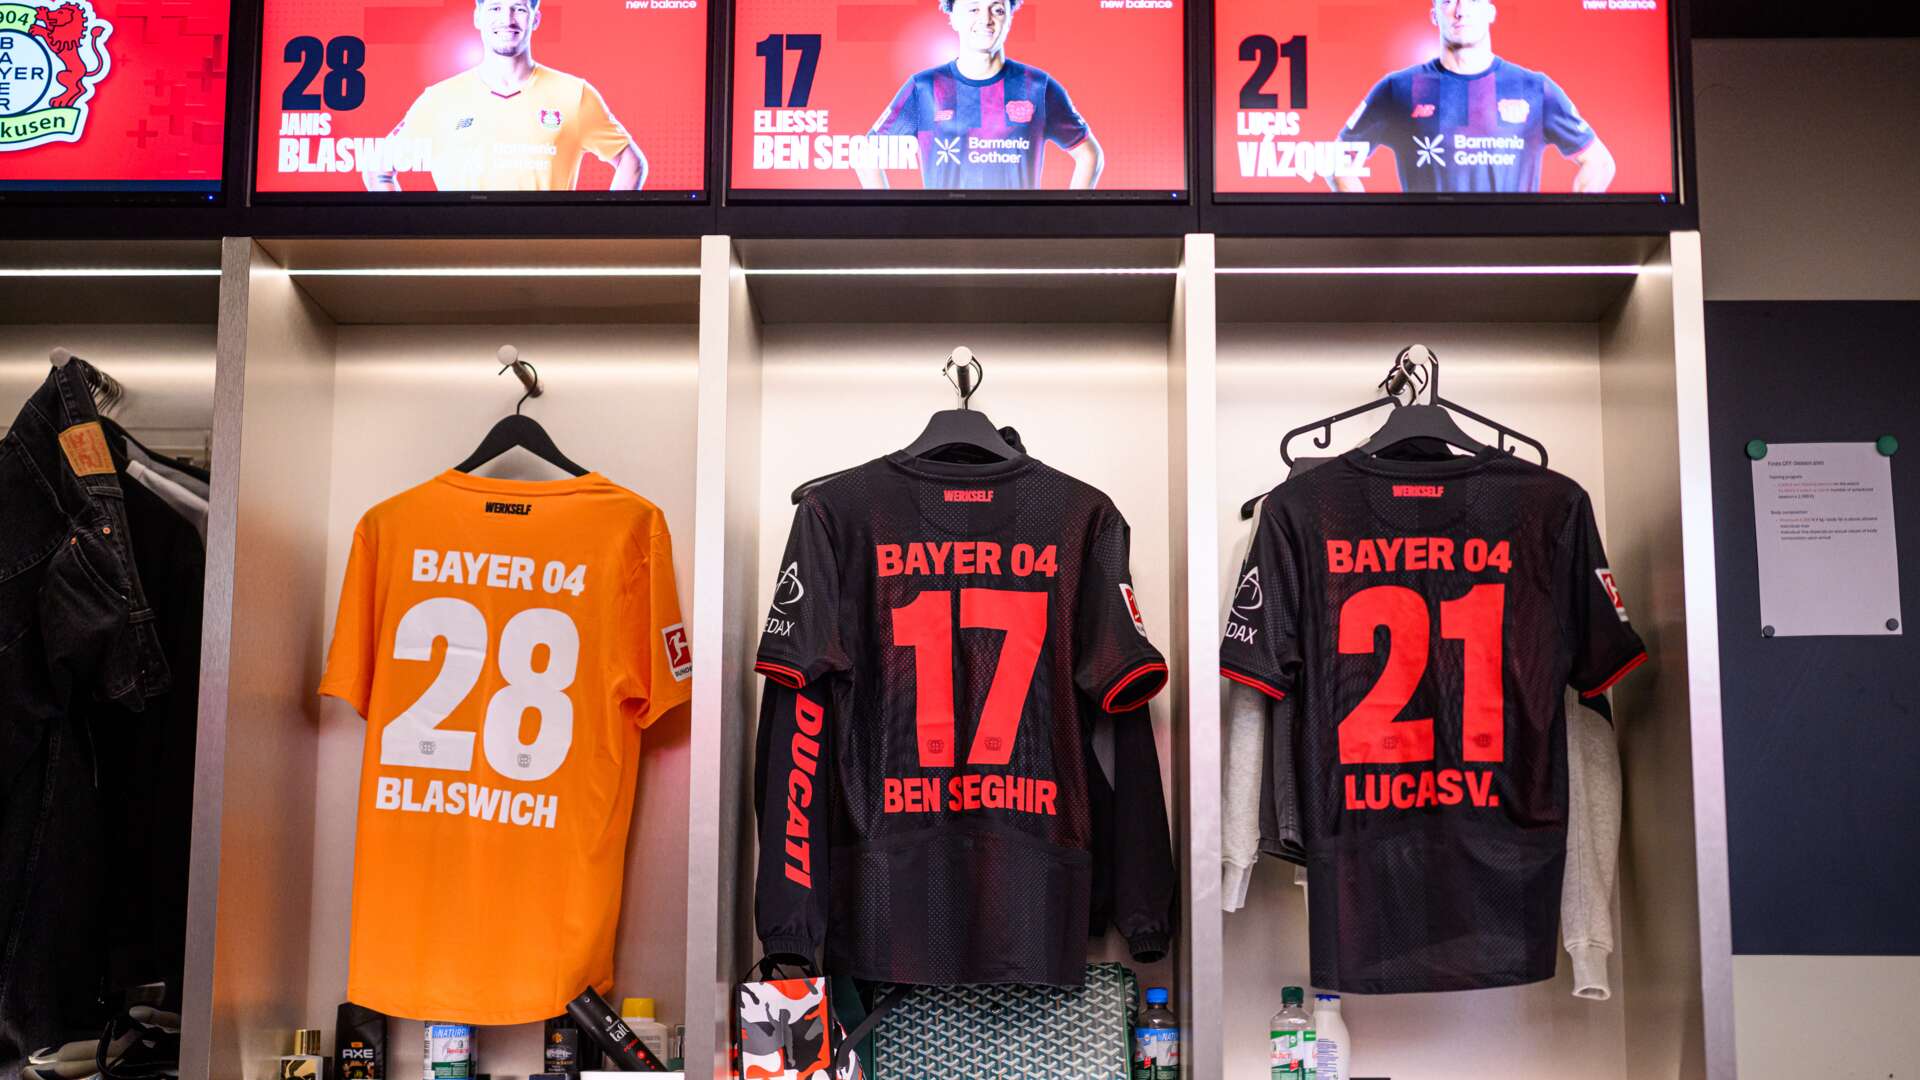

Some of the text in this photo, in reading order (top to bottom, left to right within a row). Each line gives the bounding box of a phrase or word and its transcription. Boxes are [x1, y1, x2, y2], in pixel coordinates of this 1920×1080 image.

[626, 0, 697, 8] new balance
[282, 35, 366, 111] 28
[756, 34, 822, 107] 17
[1239, 34, 1308, 109] 21
[279, 112, 332, 136] JANIS
[754, 110, 829, 133] ELIESSE
[753, 135, 919, 169] BEN SEGHIR
[968, 137, 1030, 149] Barmenia
[1454, 134, 1524, 149] Barmenia
[968, 151, 1022, 163] Gothaer
[1454, 151, 1515, 165] Gothaer
[943, 490, 994, 502] WERKSELF
[1392, 485, 1444, 498] WERKSELF
[485, 501, 533, 515] WERKSELF
[876, 541, 1058, 577] BAYER 04
[1326, 537, 1512, 574] BAYER 04
[412, 549, 587, 596] BAYER 04
[763, 617, 795, 637] DAX
[1225, 621, 1258, 644] DAX
[891, 588, 1049, 768] 17
[1337, 583, 1505, 765] 21
[380, 596, 580, 782] 28
[376, 776, 558, 829] BLASWICH
[785, 692, 825, 889] DUCATI
[884, 774, 1057, 815] BEN SEGHIR
[342, 1049, 374, 1058] AXE
